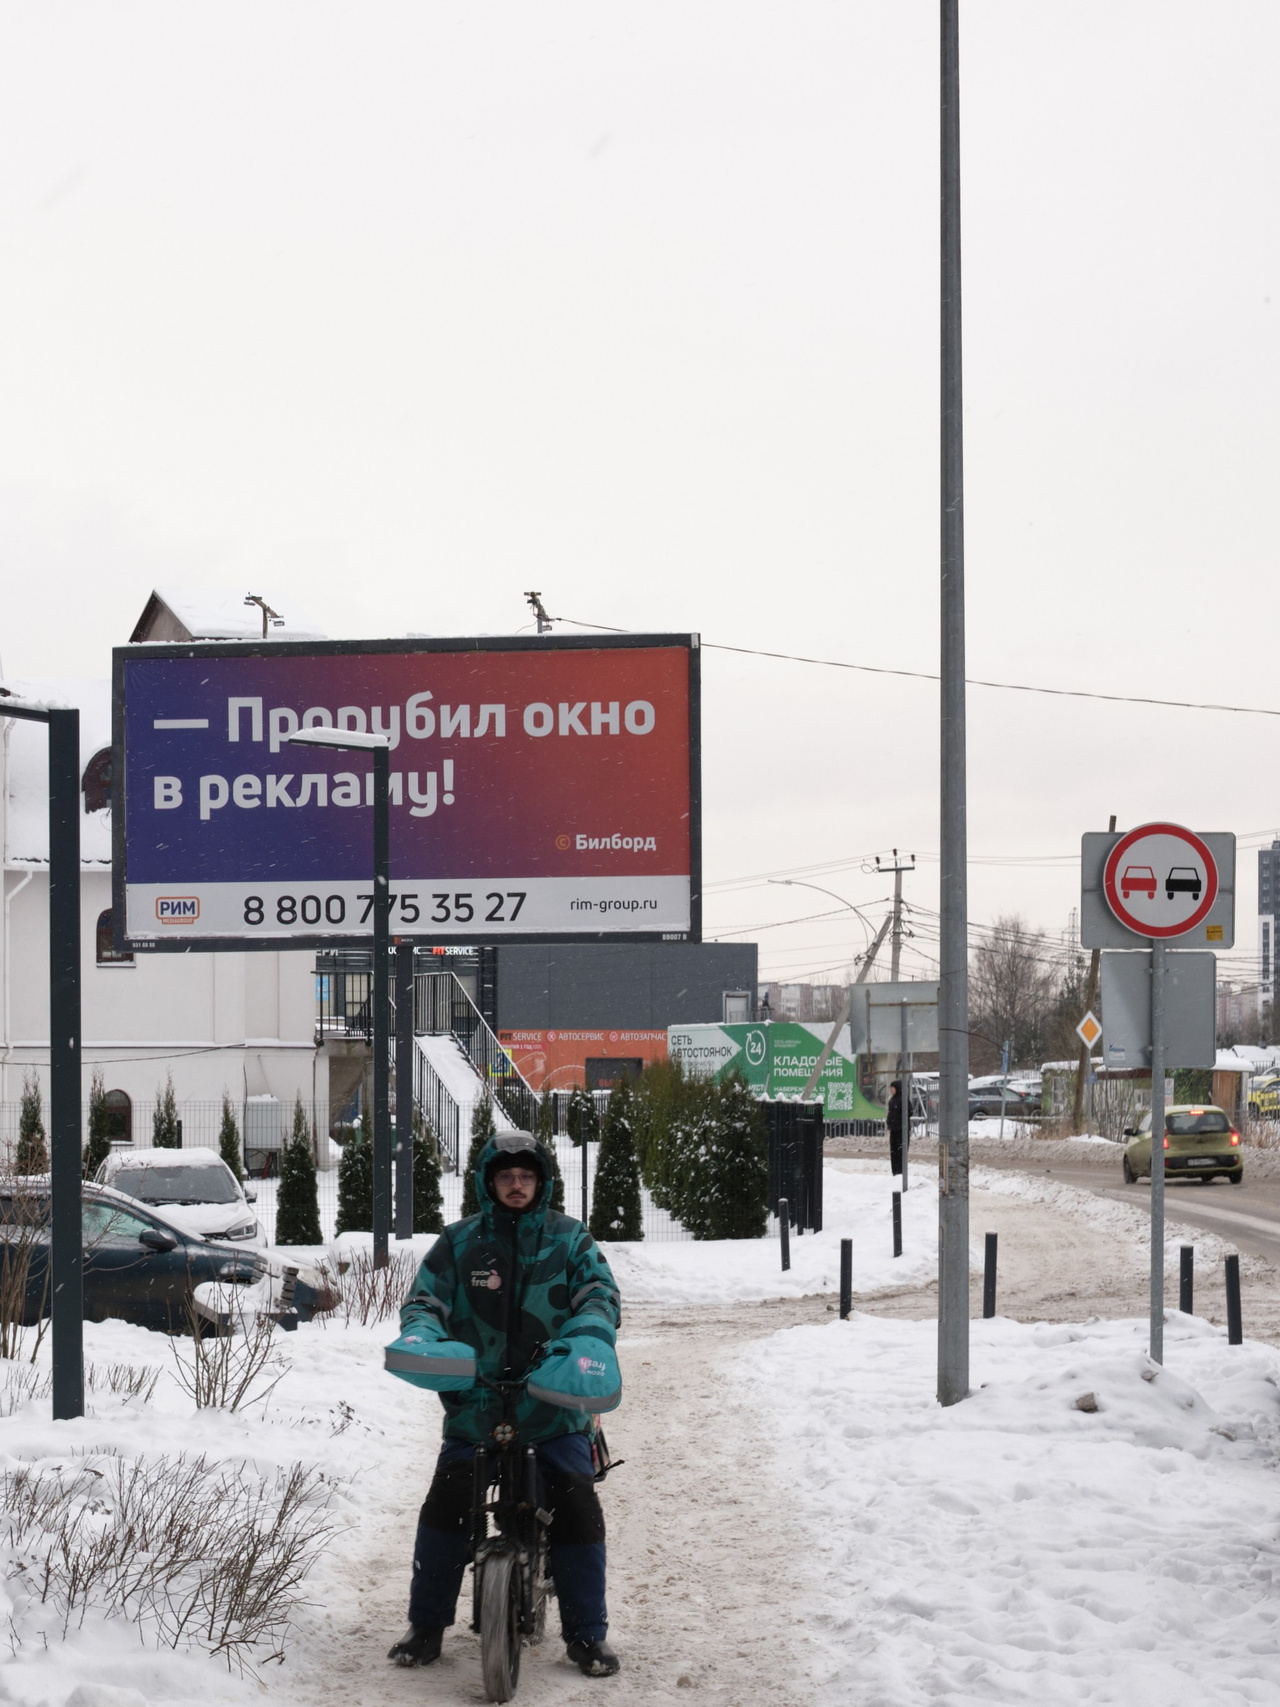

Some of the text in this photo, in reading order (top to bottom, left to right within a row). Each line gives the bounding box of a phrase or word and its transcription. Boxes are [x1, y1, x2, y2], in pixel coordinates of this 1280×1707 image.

[228, 689, 506, 753] Прорубил
[523, 700, 655, 737] окно
[154, 759, 455, 820] в рекламу!
[575, 834, 657, 852] Билборд
[160, 900, 196, 916] РИМ
[243, 896, 265, 926] 8
[276, 895, 346, 925] 800
[430, 893, 475, 924] 35
[484, 892, 527, 922] 27
[570, 899, 658, 914] rim-group.ru
[445, 947, 474, 955] SERVICE
[513, 1032, 542, 1041] SERVICE
[558, 1032, 604, 1041] АВТОСЕРВИС
[671, 1034, 693, 1046] СЕТЬ
[671, 1046, 732, 1058] АВТОСТОЯНОК
[750, 1042, 762, 1055] 24
[774, 1056, 843, 1067] КЛАДОЫЕ
[581, 1357, 606, 1371] fresh
